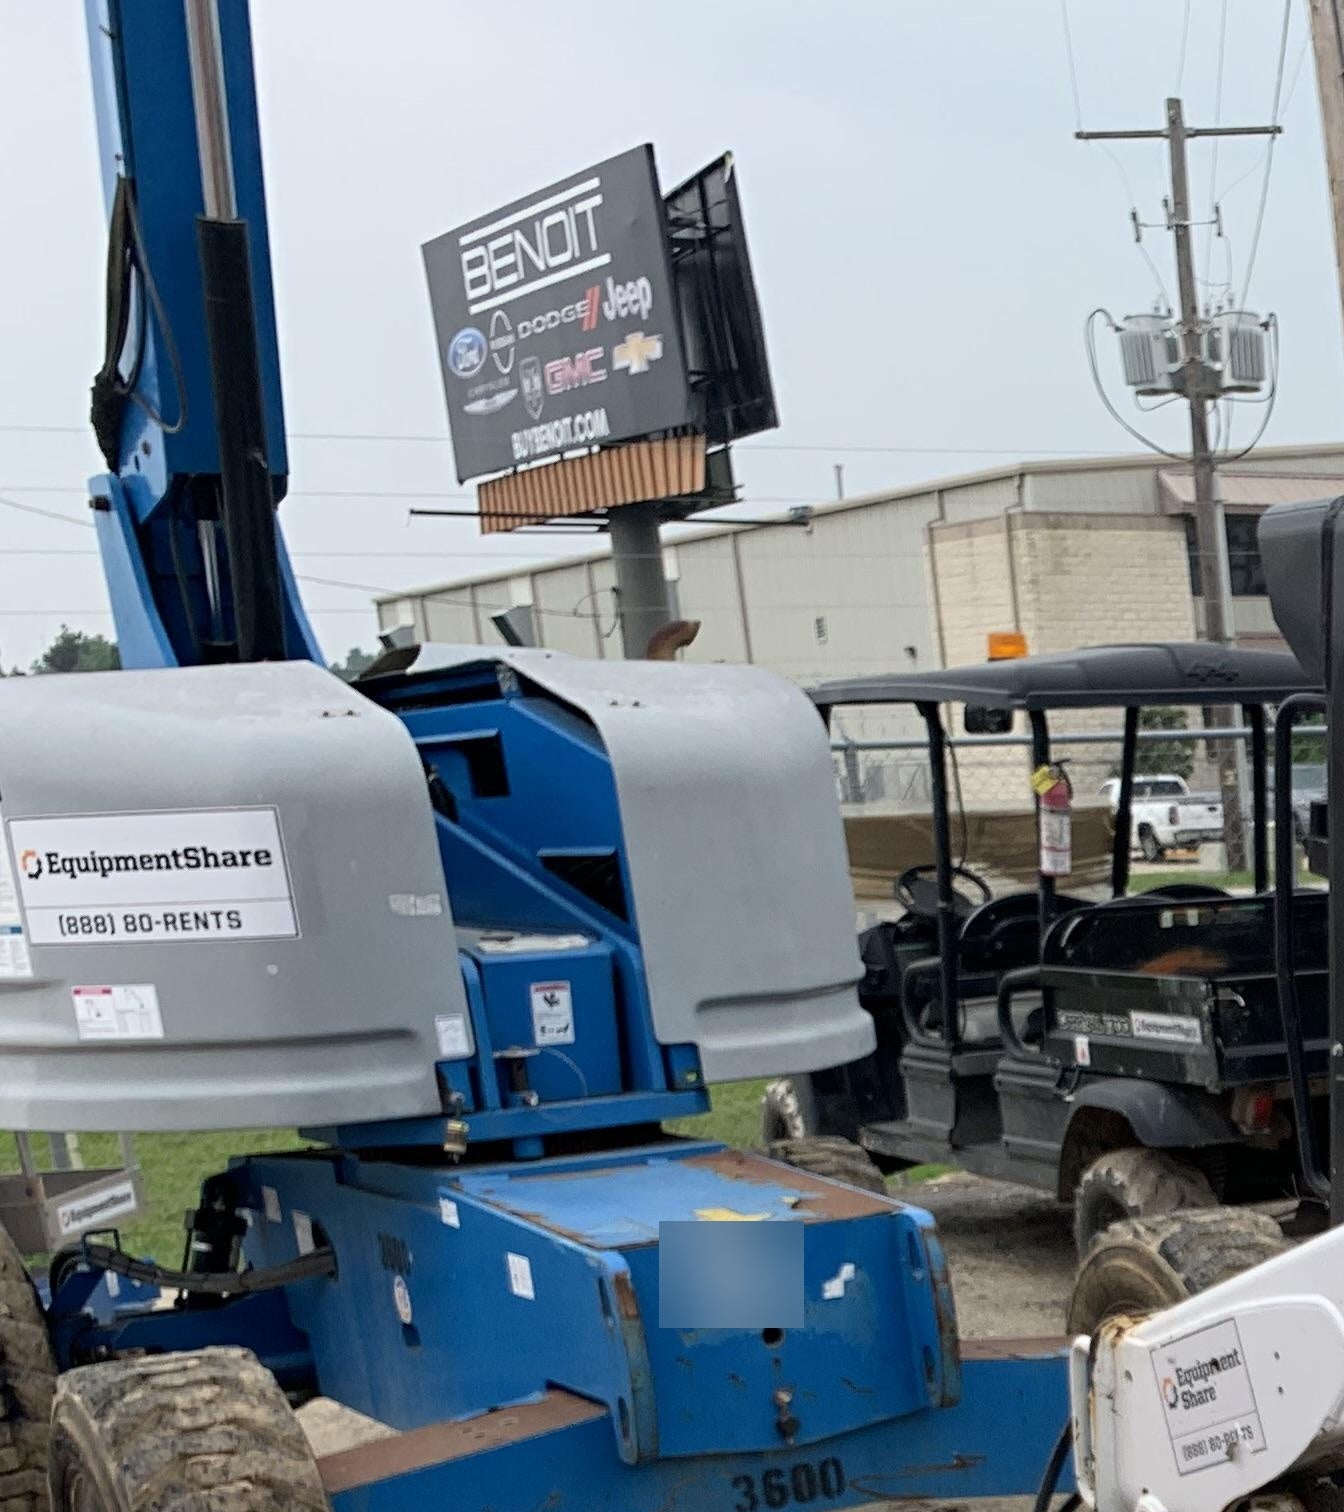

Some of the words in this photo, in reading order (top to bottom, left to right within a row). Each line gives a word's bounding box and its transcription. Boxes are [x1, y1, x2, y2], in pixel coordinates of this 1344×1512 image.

[460, 193, 603, 301] BENOIT
[517, 299, 591, 339] DODGE
[602, 275, 653, 322] Jeep
[543, 346, 608, 396] GMC
[45, 846, 273, 879] EquipmentShare
[58, 913, 116, 936] (888)
[124, 910, 243, 934] 80-RENTS
[1181, 1386, 1217, 1410] Share
